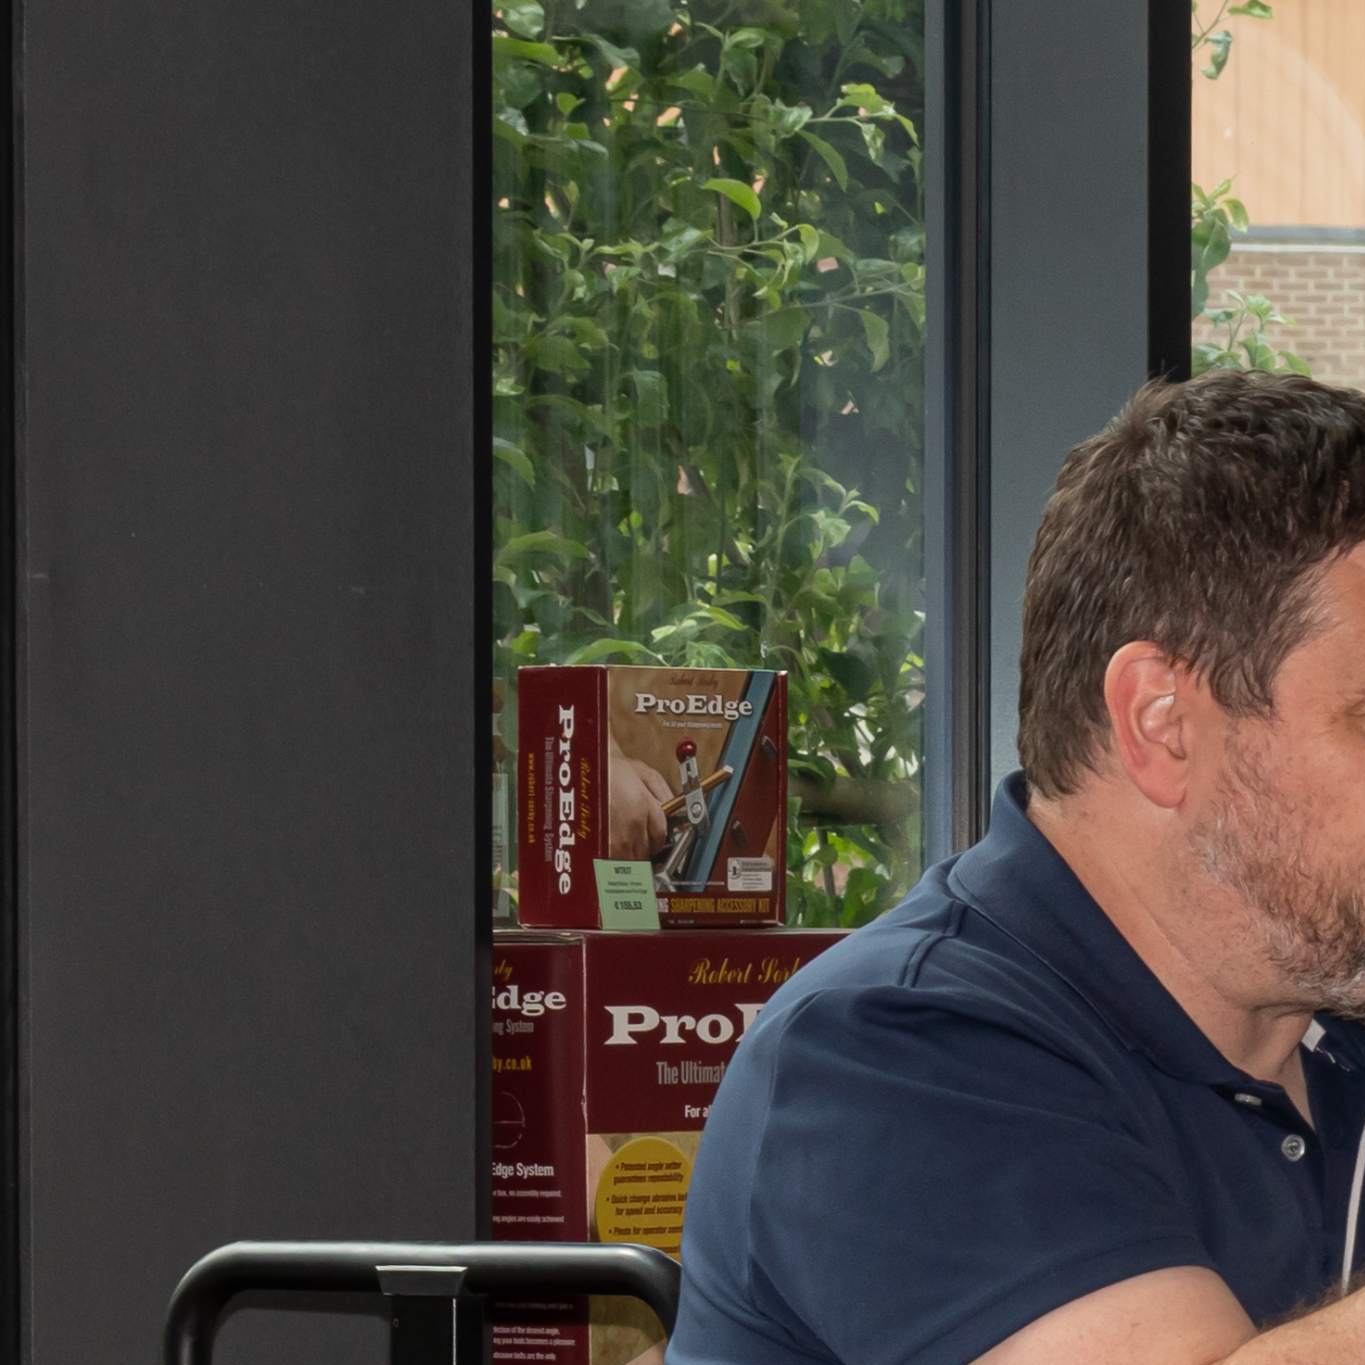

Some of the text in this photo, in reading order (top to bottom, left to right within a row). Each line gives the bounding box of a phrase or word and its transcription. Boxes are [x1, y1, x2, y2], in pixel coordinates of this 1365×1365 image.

[635, 693, 753, 720] ProEdge
[555, 704, 576, 895] ProEdge
[656, 1060, 725, 1086] The Ultimat
[684, 1104, 700, 1119] For
[516, 1162, 554, 1179] System
